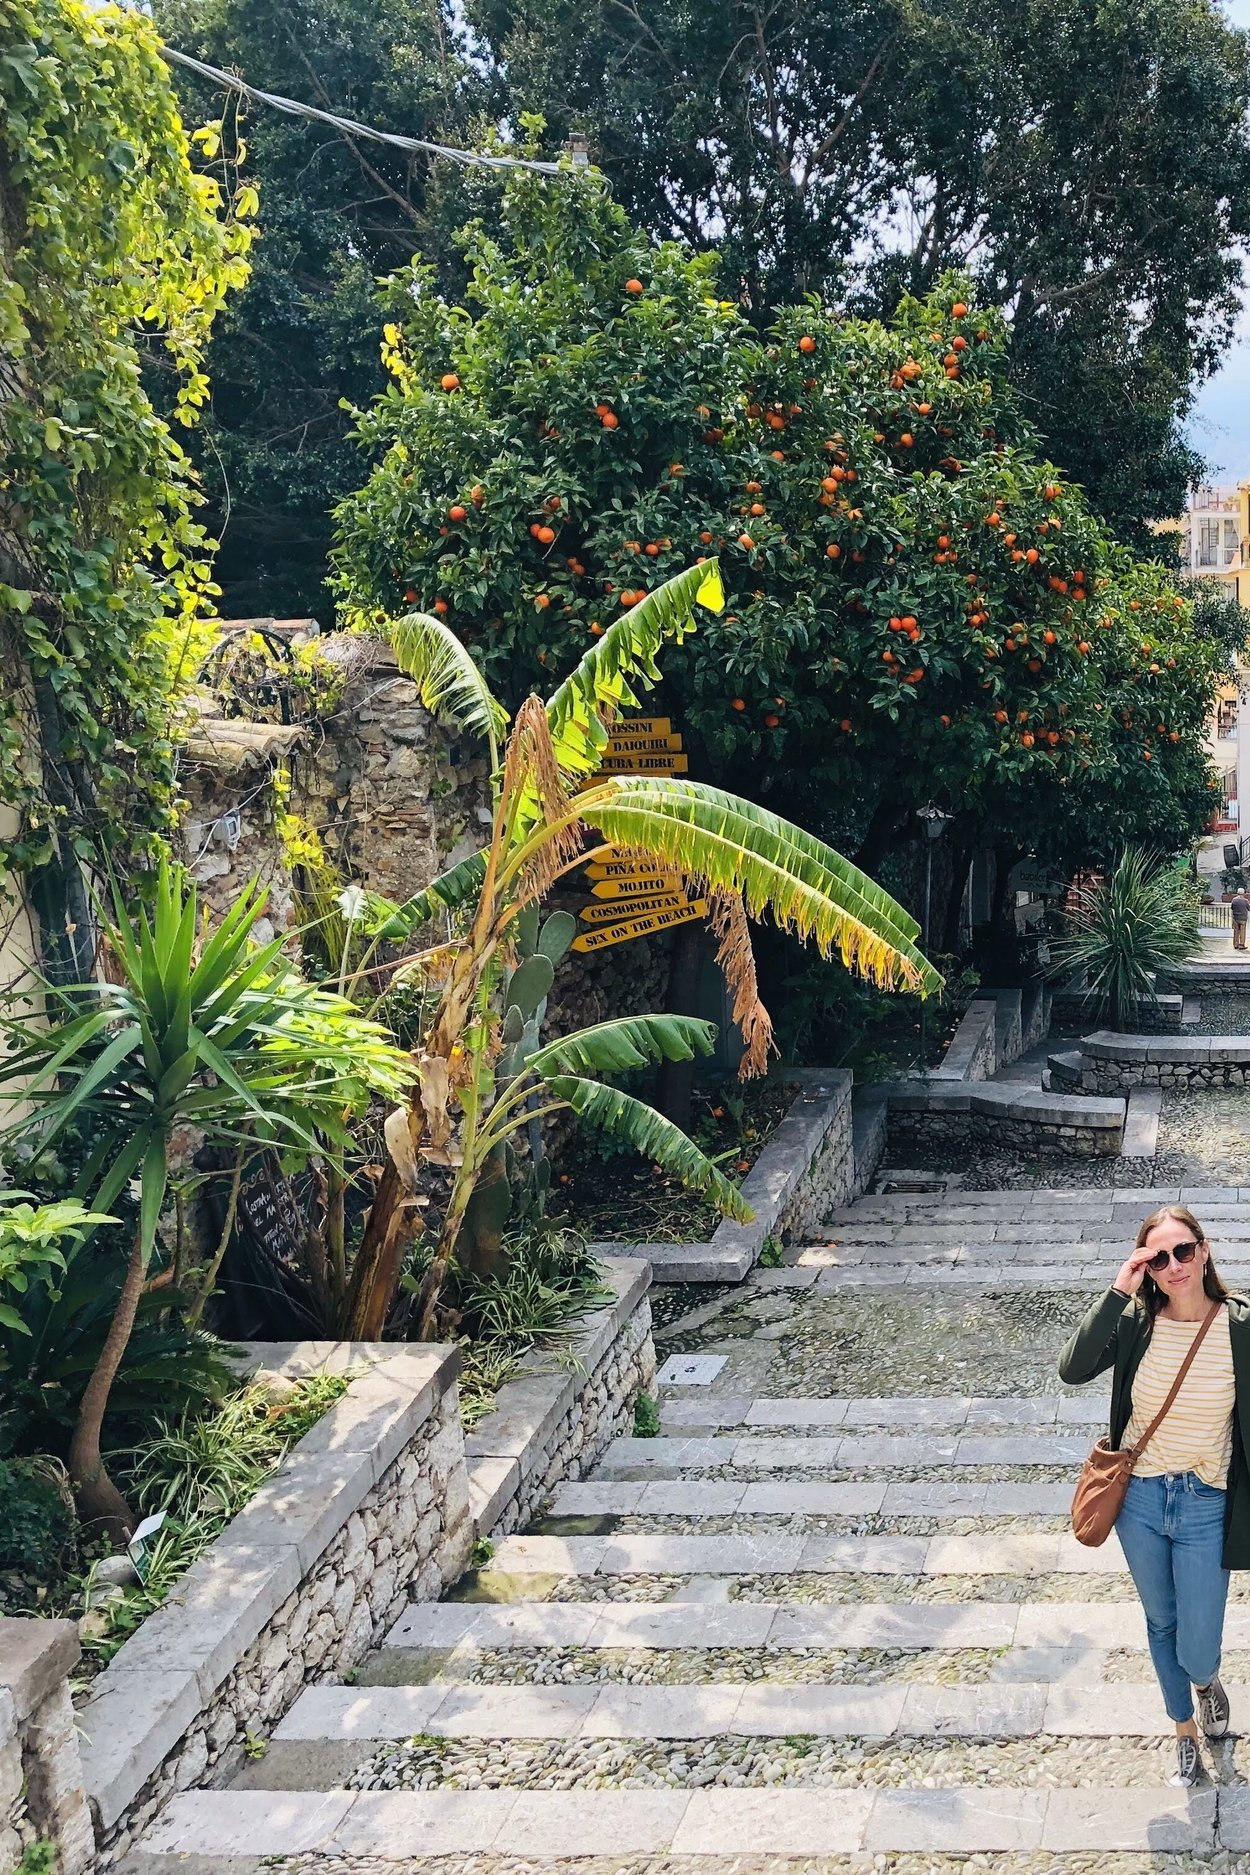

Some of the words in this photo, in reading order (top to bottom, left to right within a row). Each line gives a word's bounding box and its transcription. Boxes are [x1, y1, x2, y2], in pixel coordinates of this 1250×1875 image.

[613, 738, 668, 752] DAIQUIRI
[601, 758, 633, 769] CUBA
[638, 757, 675, 769] LIBRE
[605, 861, 636, 876] PIÑA
[617, 879, 665, 893] MOJITO
[590, 896, 680, 919] COSMOPOLITAN
[585, 933, 609, 947] SEX
[610, 927, 629, 939] ON
[630, 918, 656, 933] THE
[656, 905, 697, 925] BEACH
